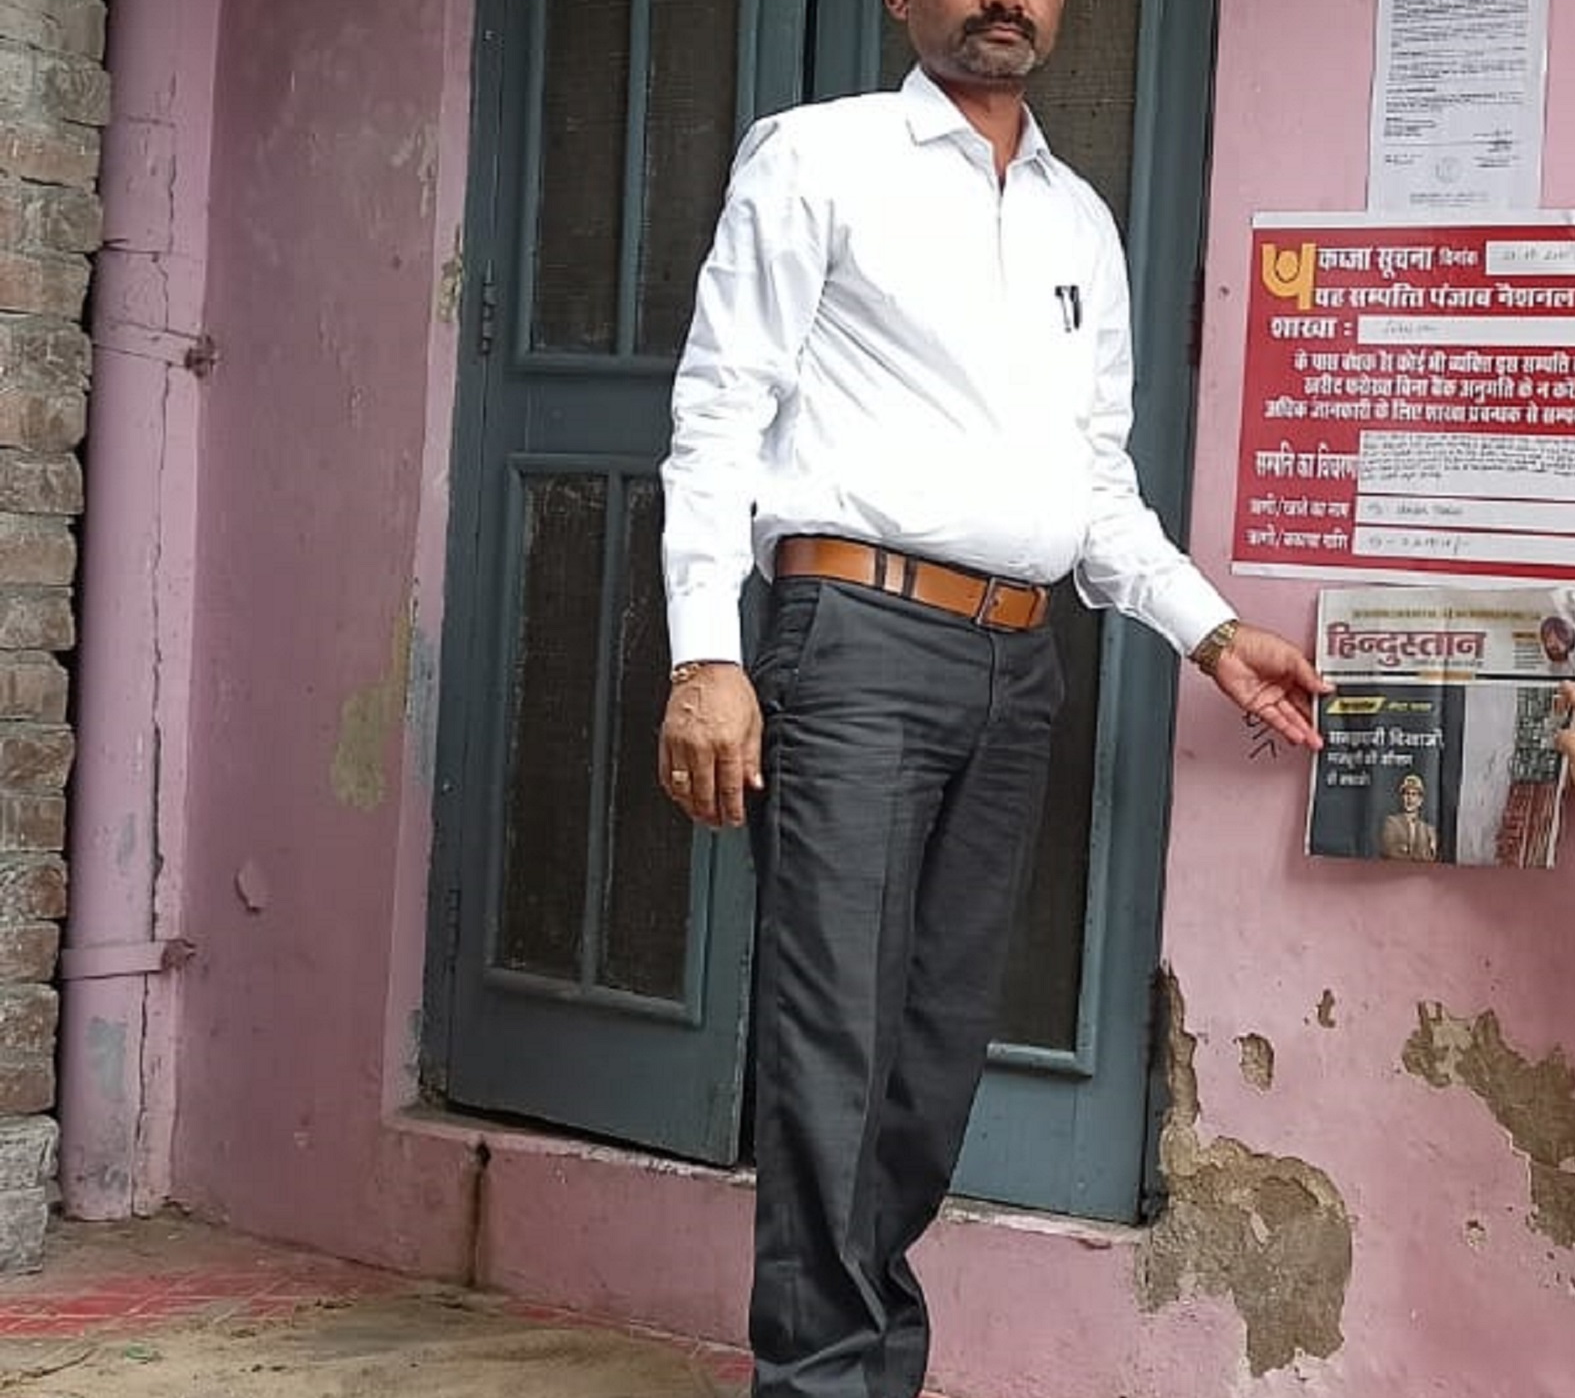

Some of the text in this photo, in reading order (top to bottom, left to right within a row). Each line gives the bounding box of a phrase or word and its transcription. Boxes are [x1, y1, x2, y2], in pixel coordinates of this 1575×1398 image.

[1317, 246, 1371, 272] कब्जा
[1377, 246, 1435, 279] सूचना
[1314, 286, 1344, 308] यह
[1430, 283, 1492, 308] पंजाब
[1271, 317, 1337, 339] शाखा
[1326, 621, 1487, 667] हिन्दुस्तान
